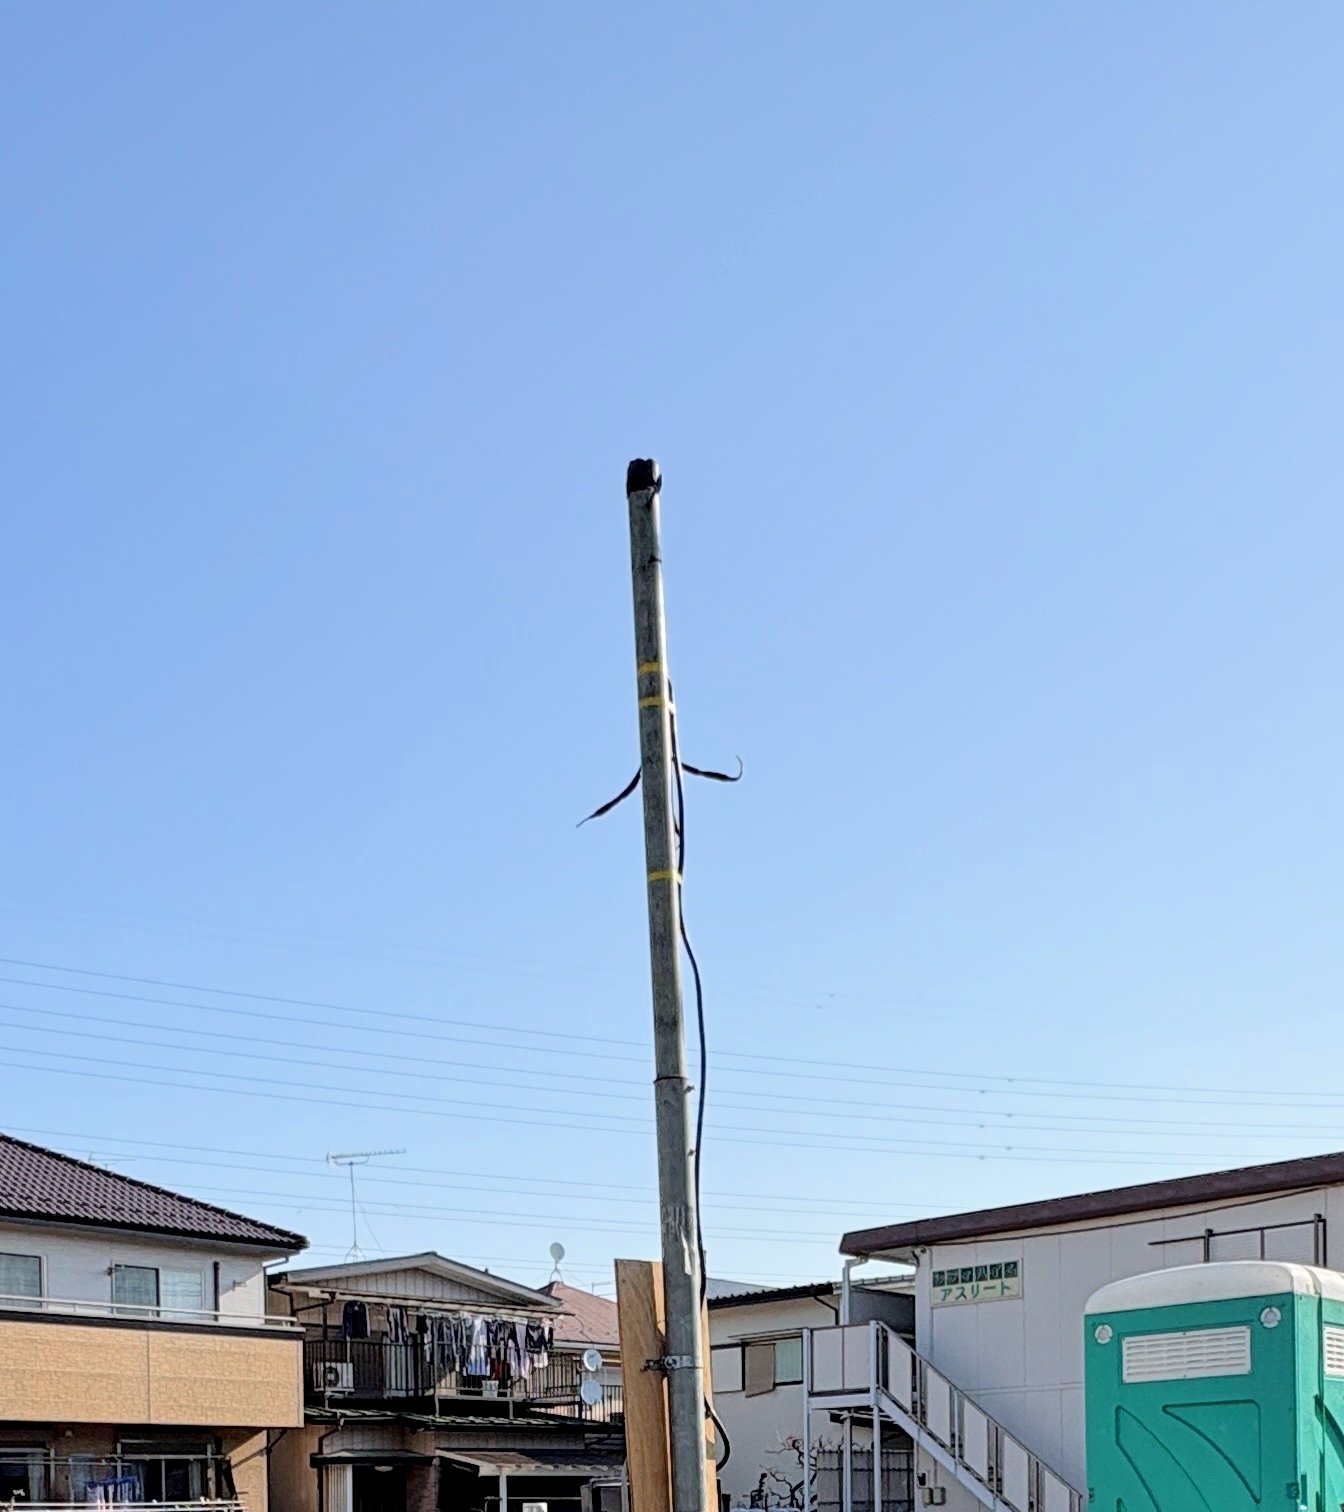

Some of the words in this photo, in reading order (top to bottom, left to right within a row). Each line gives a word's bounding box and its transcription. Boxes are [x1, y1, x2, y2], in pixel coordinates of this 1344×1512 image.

[941, 1281, 1010, 1301] アスリート
